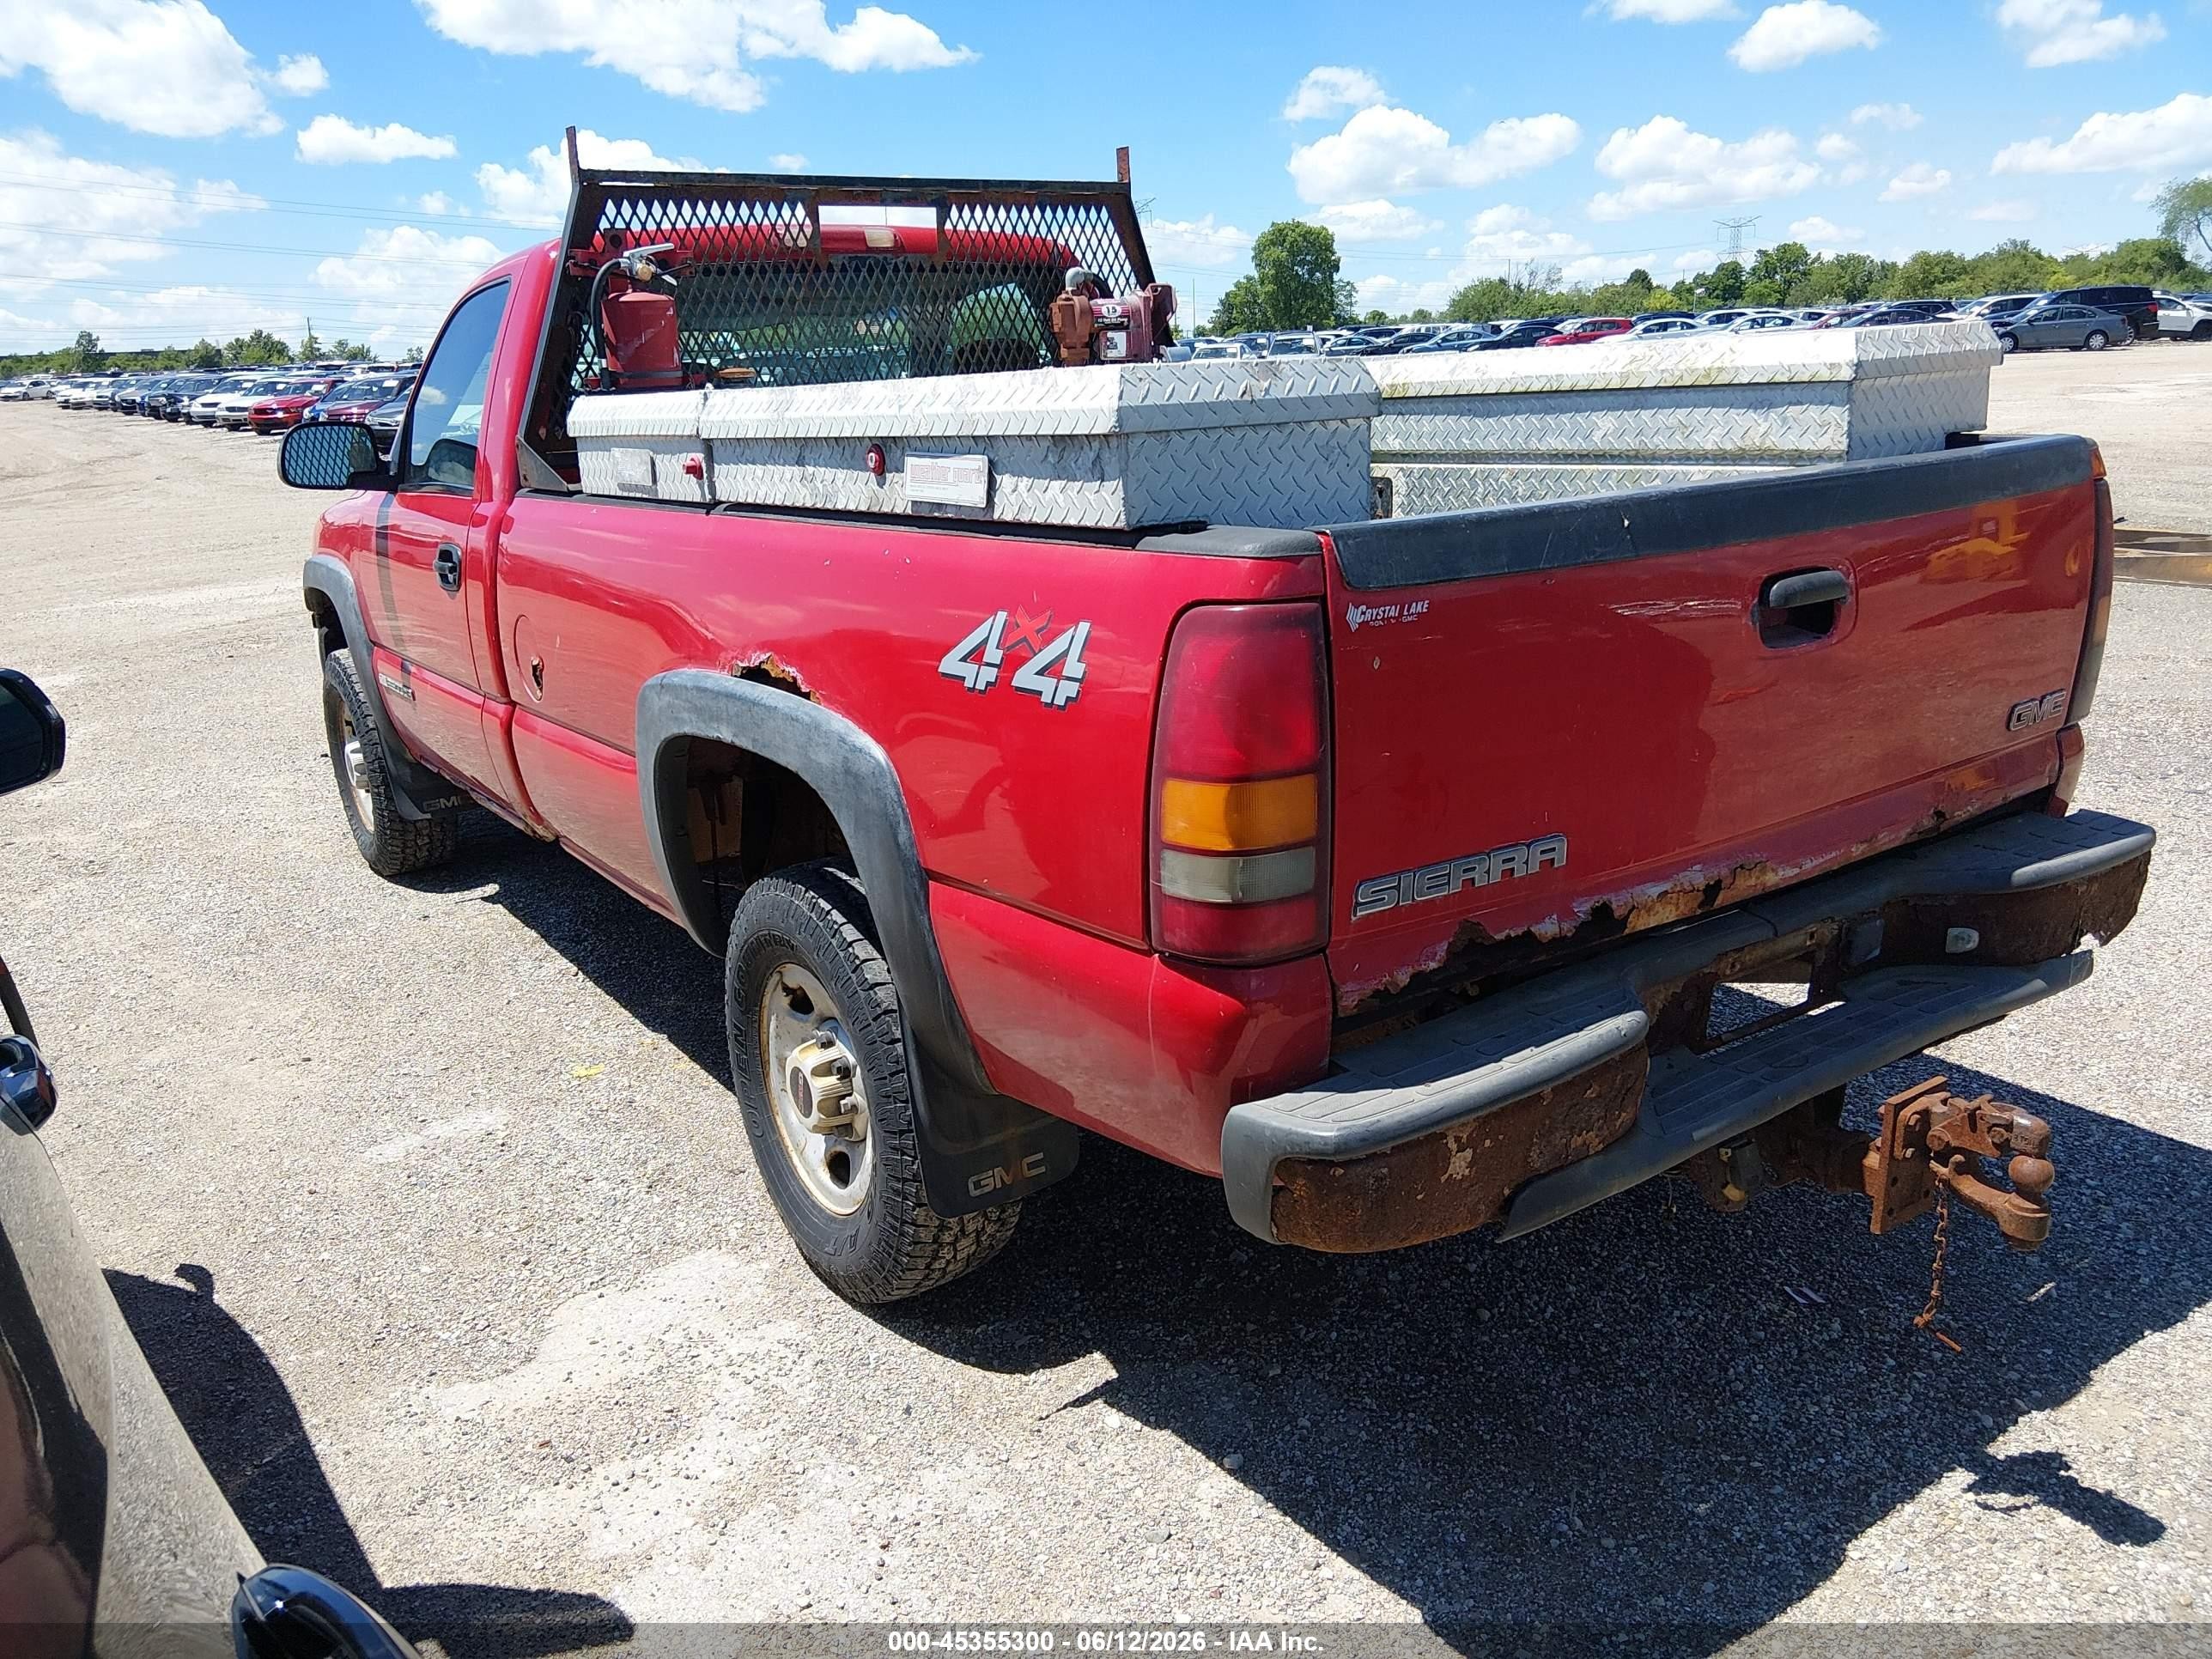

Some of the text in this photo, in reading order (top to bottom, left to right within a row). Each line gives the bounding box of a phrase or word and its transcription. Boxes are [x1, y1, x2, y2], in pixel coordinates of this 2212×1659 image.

[1403, 600, 1430, 615] LAKE
[2008, 690, 2067, 732] GMC
[1354, 835, 1568, 916] SIERRA
[968, 1152, 1046, 1197] GMC
